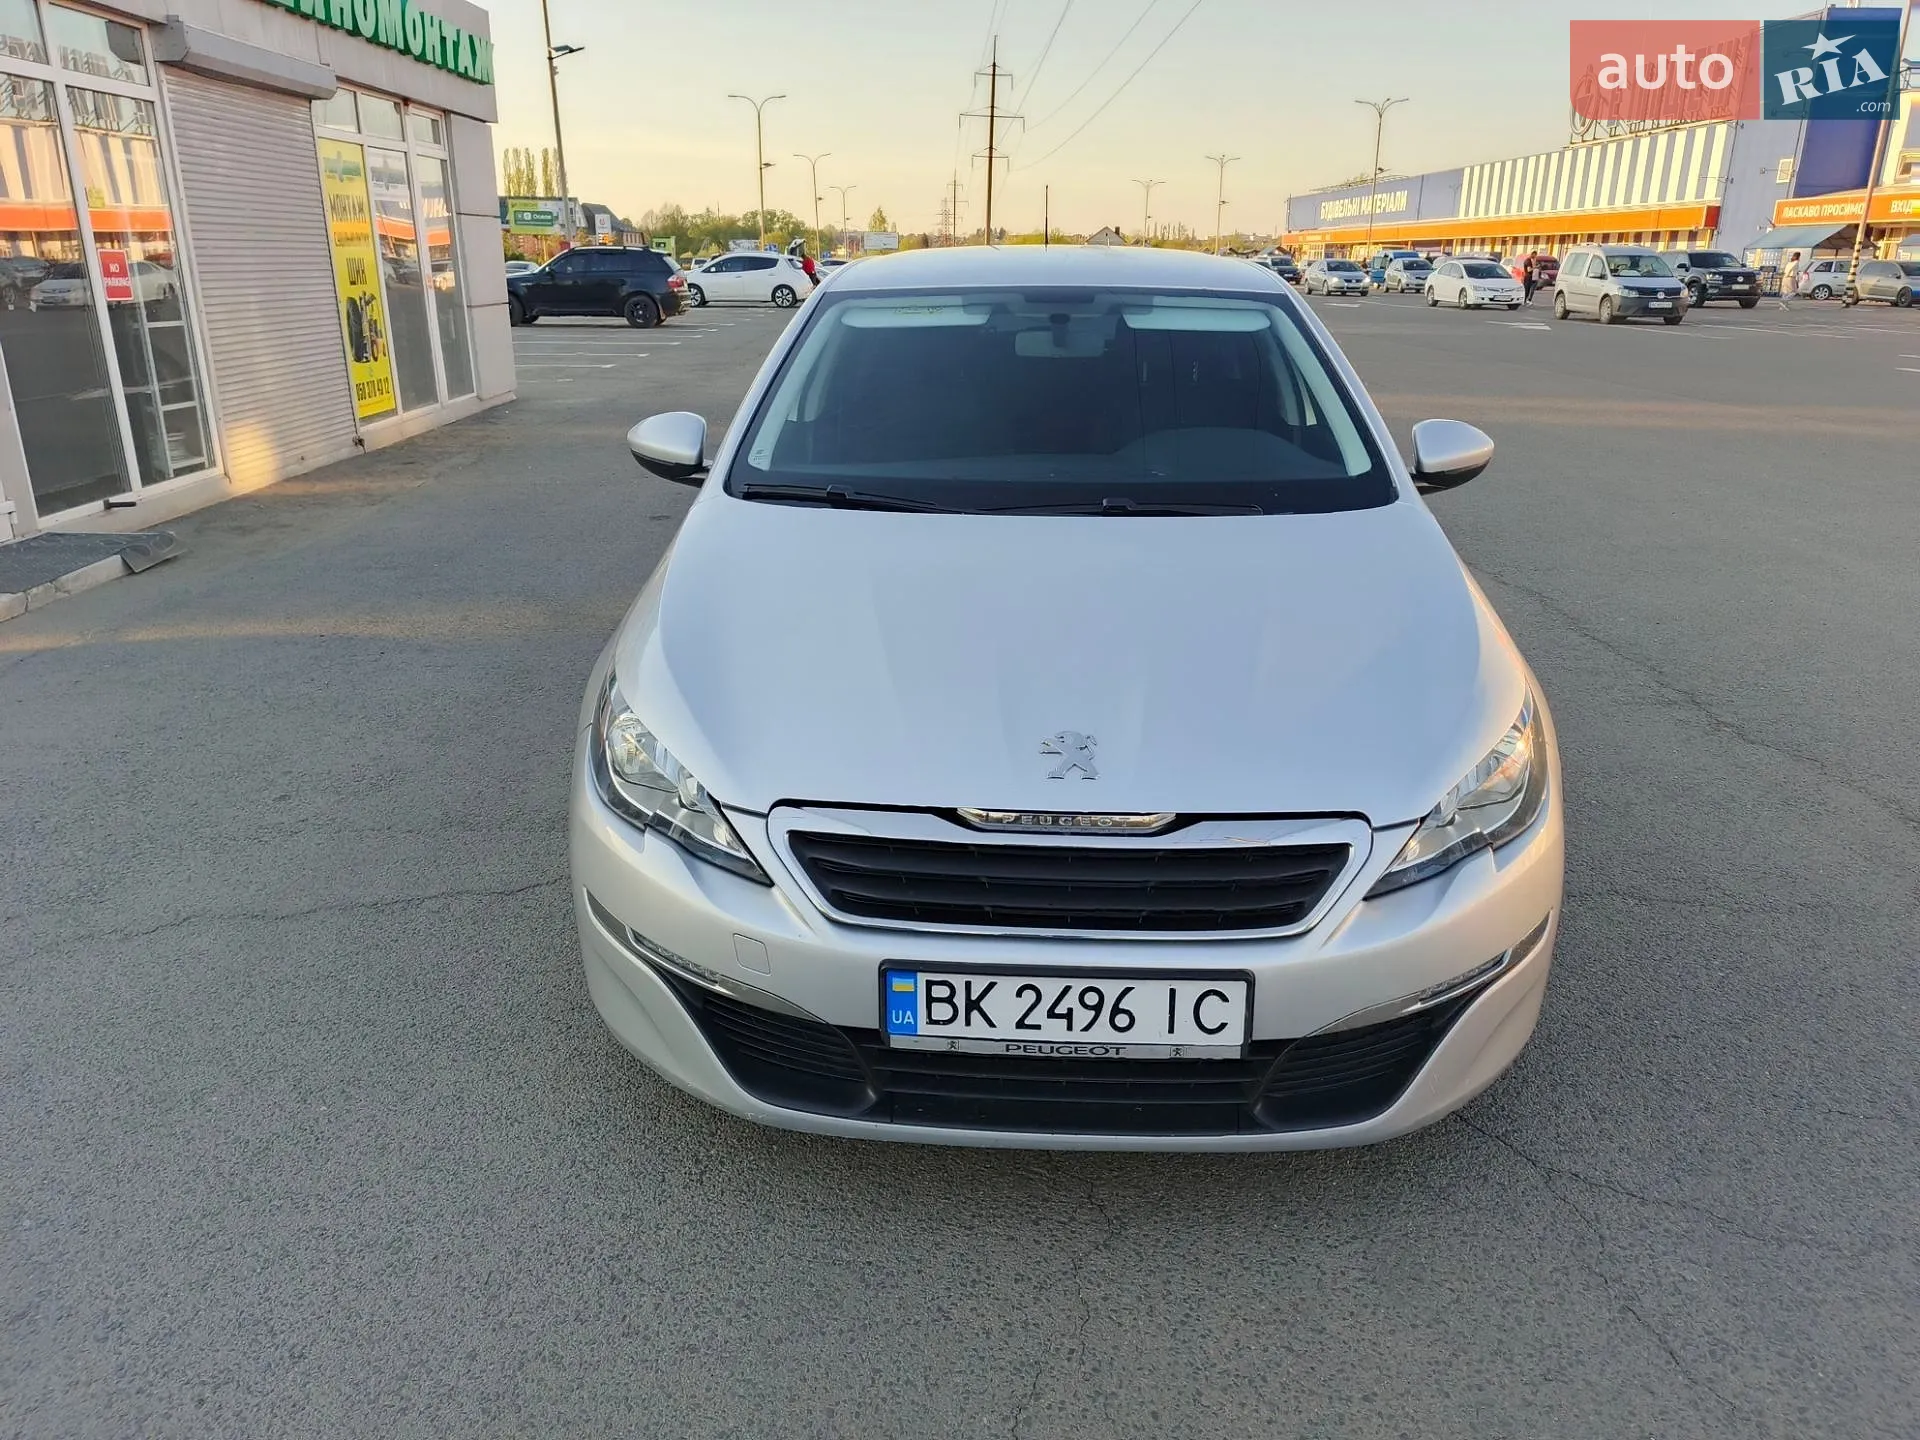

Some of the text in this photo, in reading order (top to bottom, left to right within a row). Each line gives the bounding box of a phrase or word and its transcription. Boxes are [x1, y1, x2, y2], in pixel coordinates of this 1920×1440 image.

[1820, 202, 1865, 217] ПРОСИМО
[109, 263, 120, 273] NO
[1002, 815, 1131, 827] PEUGEOT
[925, 978, 1230, 1035] BK 2496 IC
[892, 1009, 915, 1025] UA
[1004, 1043, 1128, 1056] PEUGEOT
